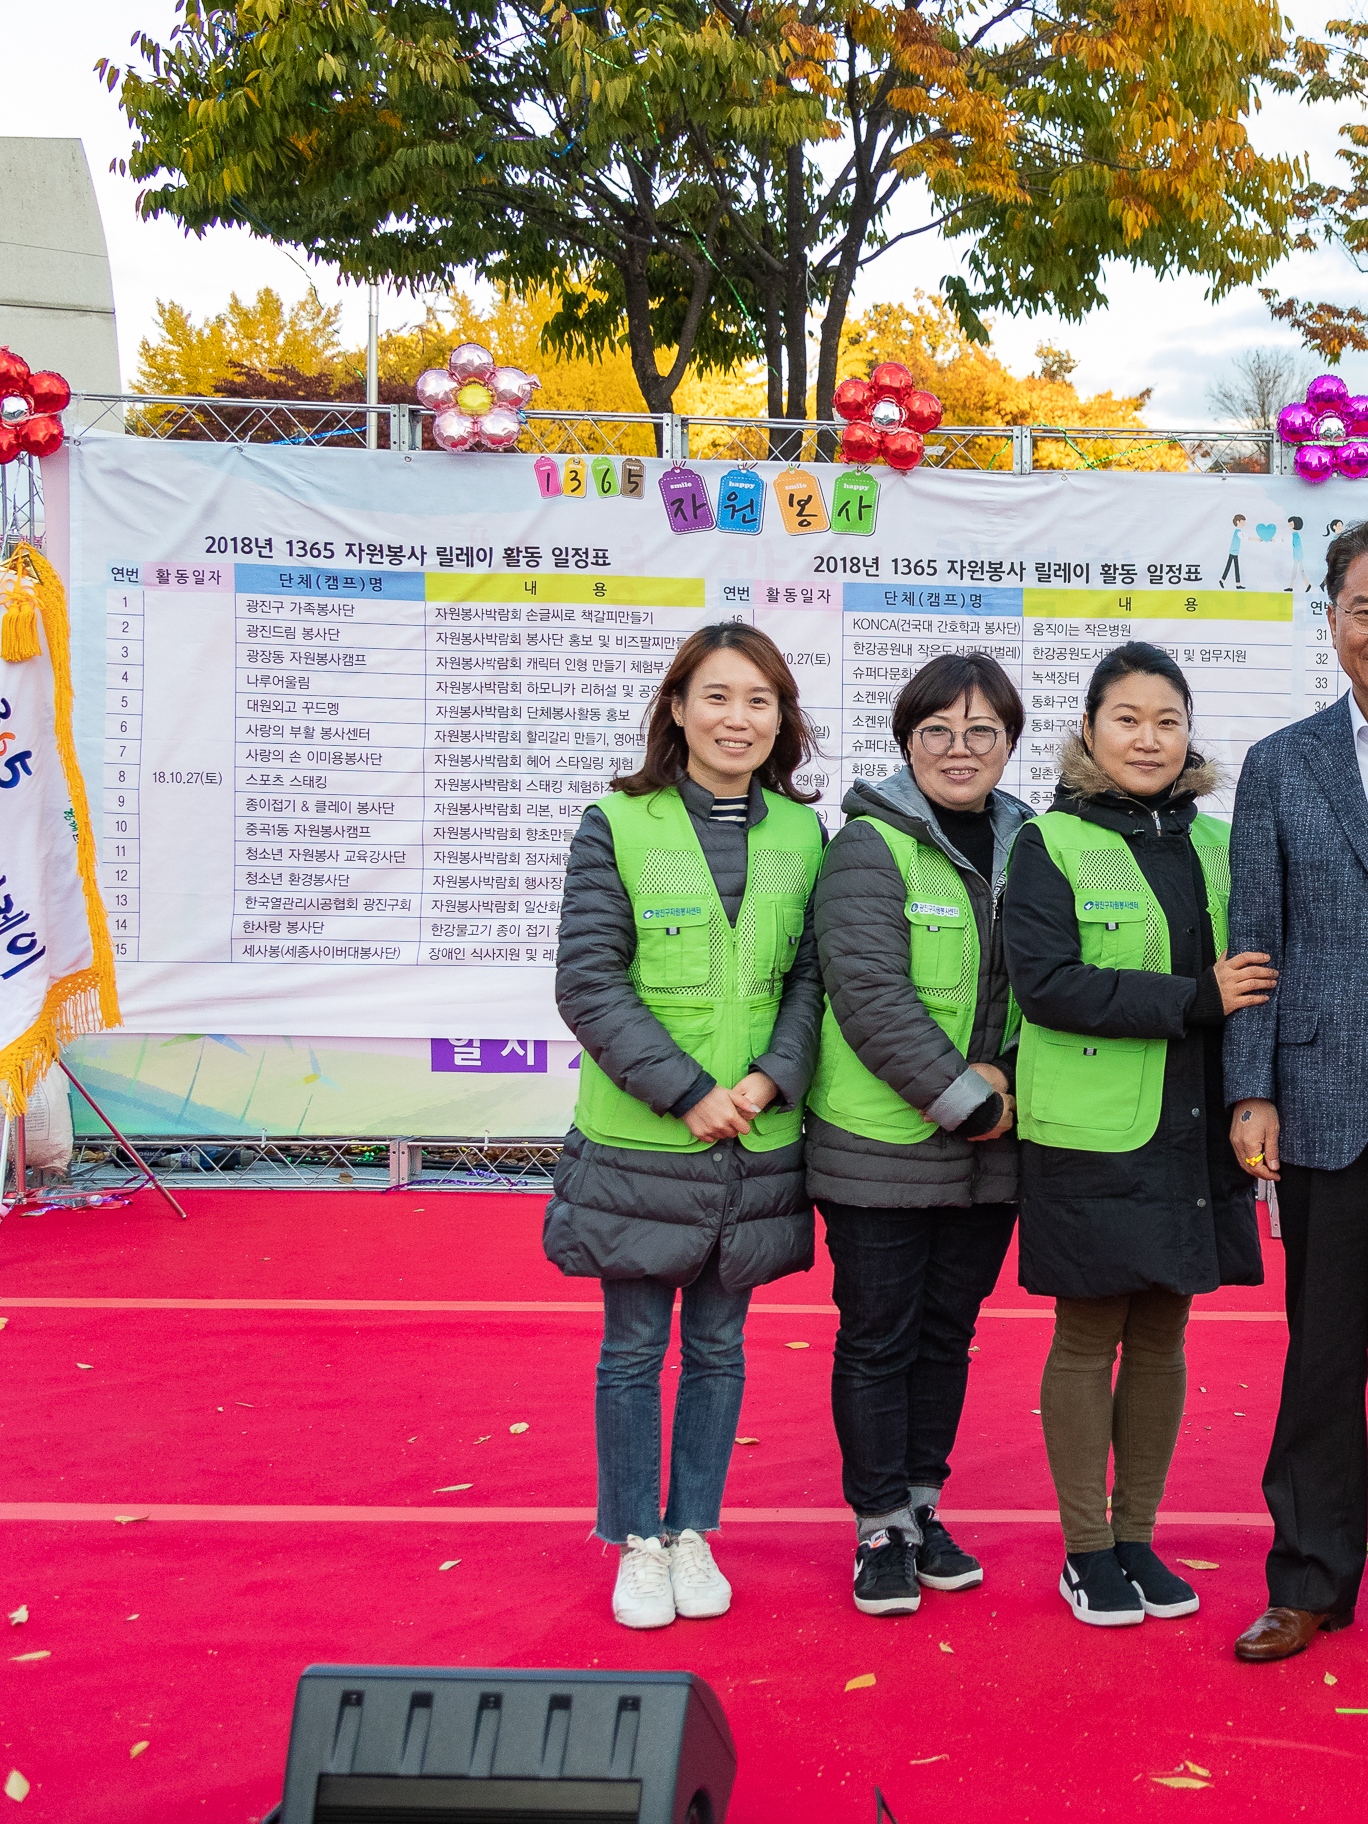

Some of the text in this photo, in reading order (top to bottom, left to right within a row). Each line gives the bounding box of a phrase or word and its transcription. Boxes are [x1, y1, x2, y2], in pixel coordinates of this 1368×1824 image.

[205, 536, 611, 569] 2018년 1365 자원봉사 릴레이 활동 일정표
[111, 567, 140, 584] 연번
[814, 556, 1203, 585] 2018년 1365 자원봉사 릴레이 활동 일정표
[724, 586, 749, 601] 연번
[123, 596, 127, 607] 1
[246, 600, 355, 617] 광진구 가족봉사단
[435, 608, 653, 624] 자원봉사박람회 손글씨로 책갈피만들기
[851, 618, 1020, 636] KONCA(건국대 간호학과 봉사단)
[1033, 623, 1130, 637] 움직이는 작은병원
[122, 646, 128, 658] 3
[247, 650, 367, 666] 광장동 자원봉사캠프
[1200, 649, 1246, 663] 업무지원
[1316, 653, 1328, 664] 32
[247, 674, 309, 689] 나루어울림
[1032, 671, 1079, 684] 녹색장터
[247, 699, 339, 715] 대원외고 꾸드멩
[1032, 695, 1078, 708] 동화구연
[120, 746, 126, 757] 7
[246, 749, 382, 766] 사랑의 손 이미용봉사단
[434, 754, 632, 772] 자원봉사박람회 헤어 스타일링 체험
[153, 771, 222, 786] 18.10.27(토)
[246, 774, 327, 789] 스포츠 스태킹
[246, 798, 395, 815] 종이접기 & 클레이 봉사단
[116, 820, 127, 832] 10
[245, 896, 411, 911] 한국열관리시공협회 광진구회
[431, 924, 549, 937] 한강물고기 종이 접기
[116, 943, 127, 955] 15
[242, 945, 400, 960] 세사봉(세종사이버대봉사단)
[429, 948, 537, 961] 장애인 식사지원 및
